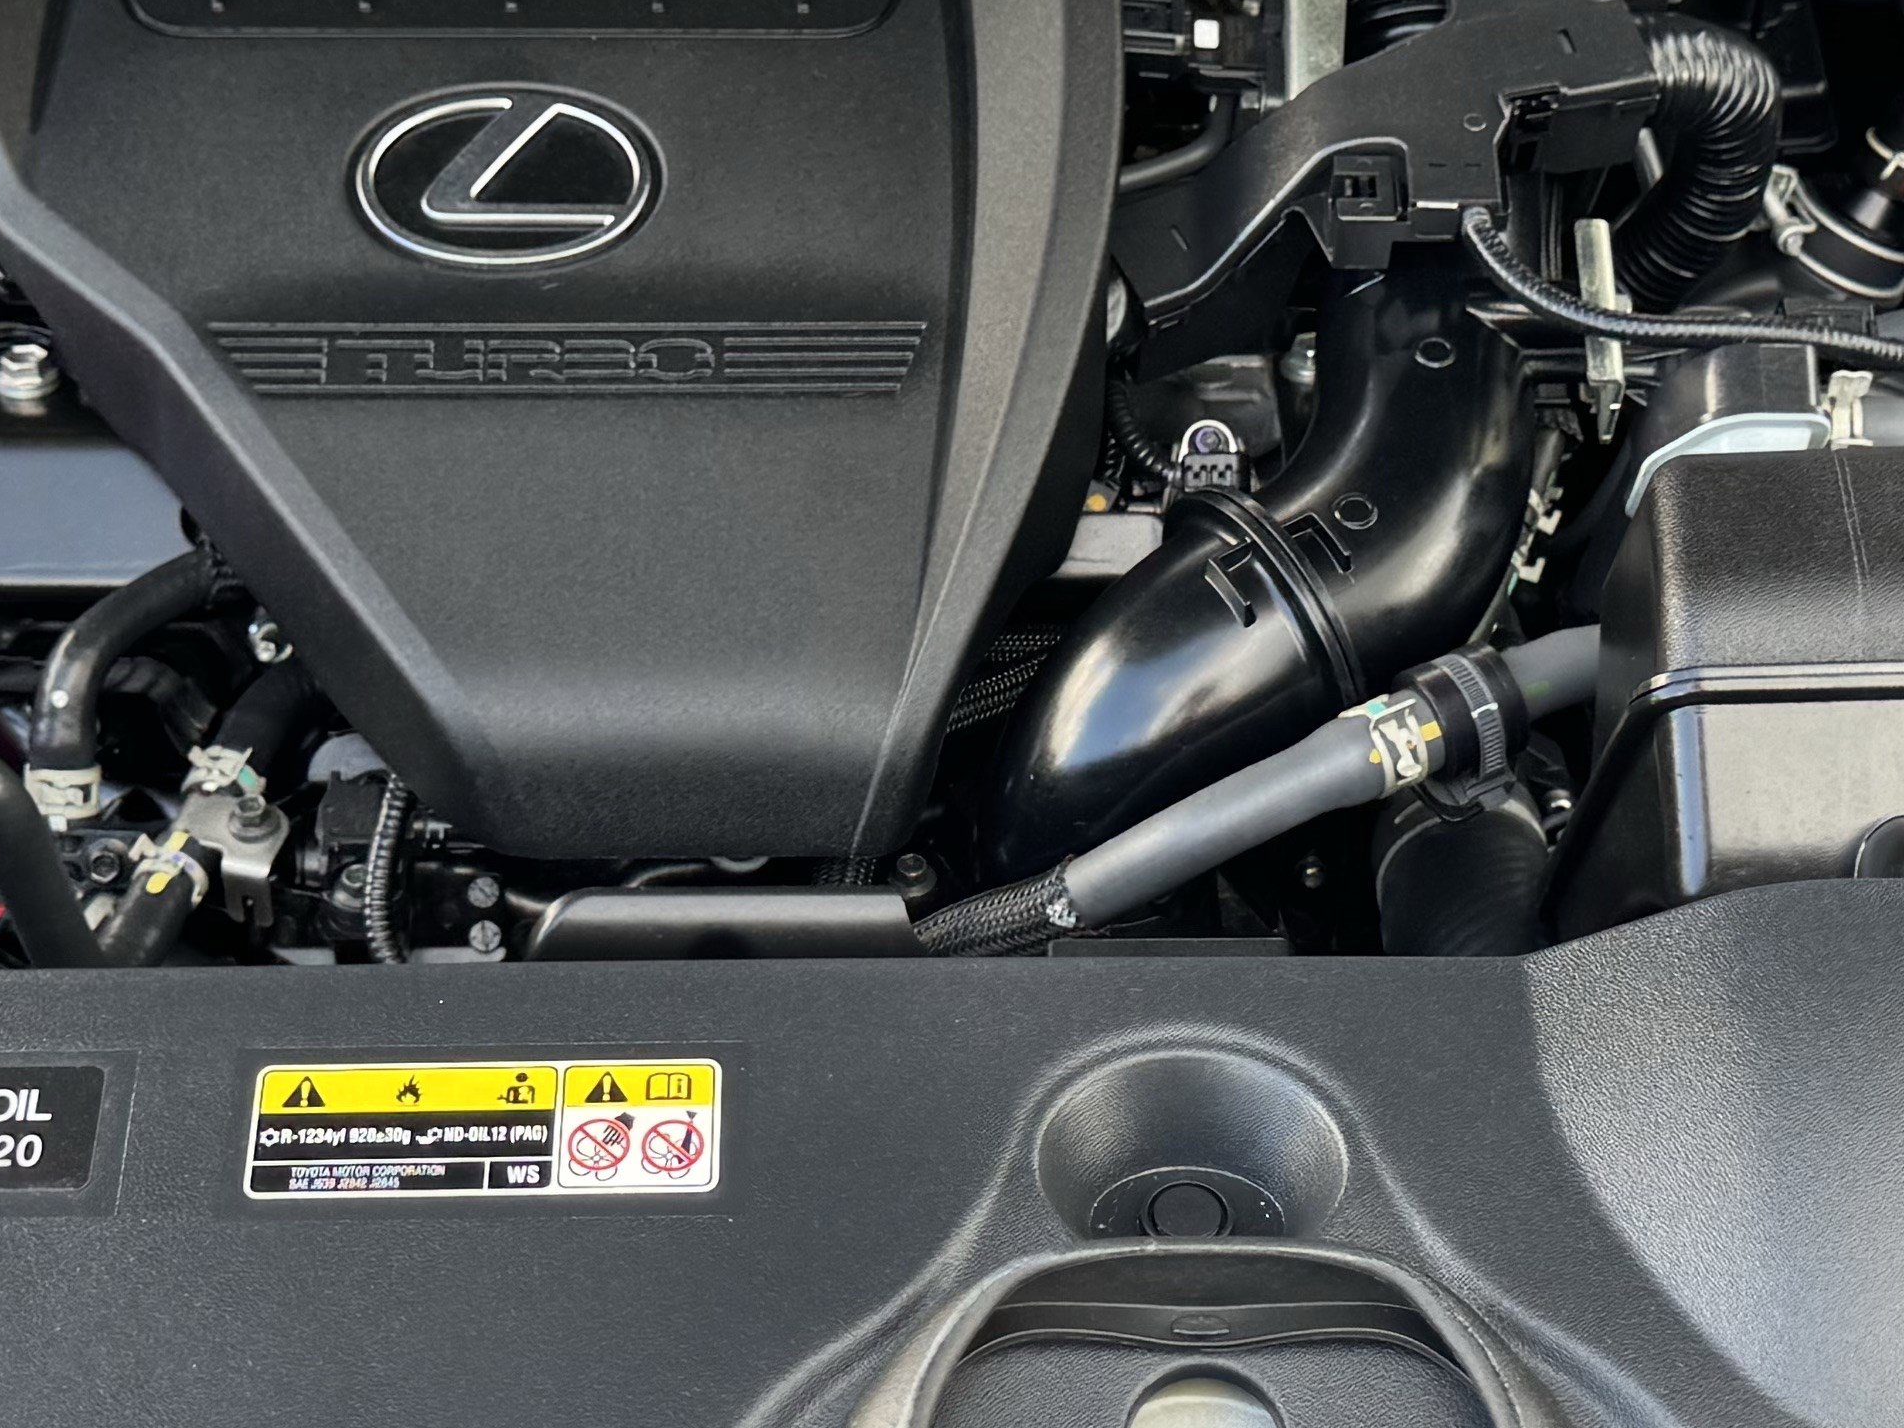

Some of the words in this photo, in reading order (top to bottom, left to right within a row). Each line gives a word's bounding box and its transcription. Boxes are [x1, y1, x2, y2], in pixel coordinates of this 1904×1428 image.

[334, 338, 716, 383] TURBO
[290, 1165, 331, 1178] TOYOTA
[332, 1165, 371, 1178] MOTOR
[372, 1164, 446, 1178] CORPORATION
[507, 1165, 540, 1184] WS
